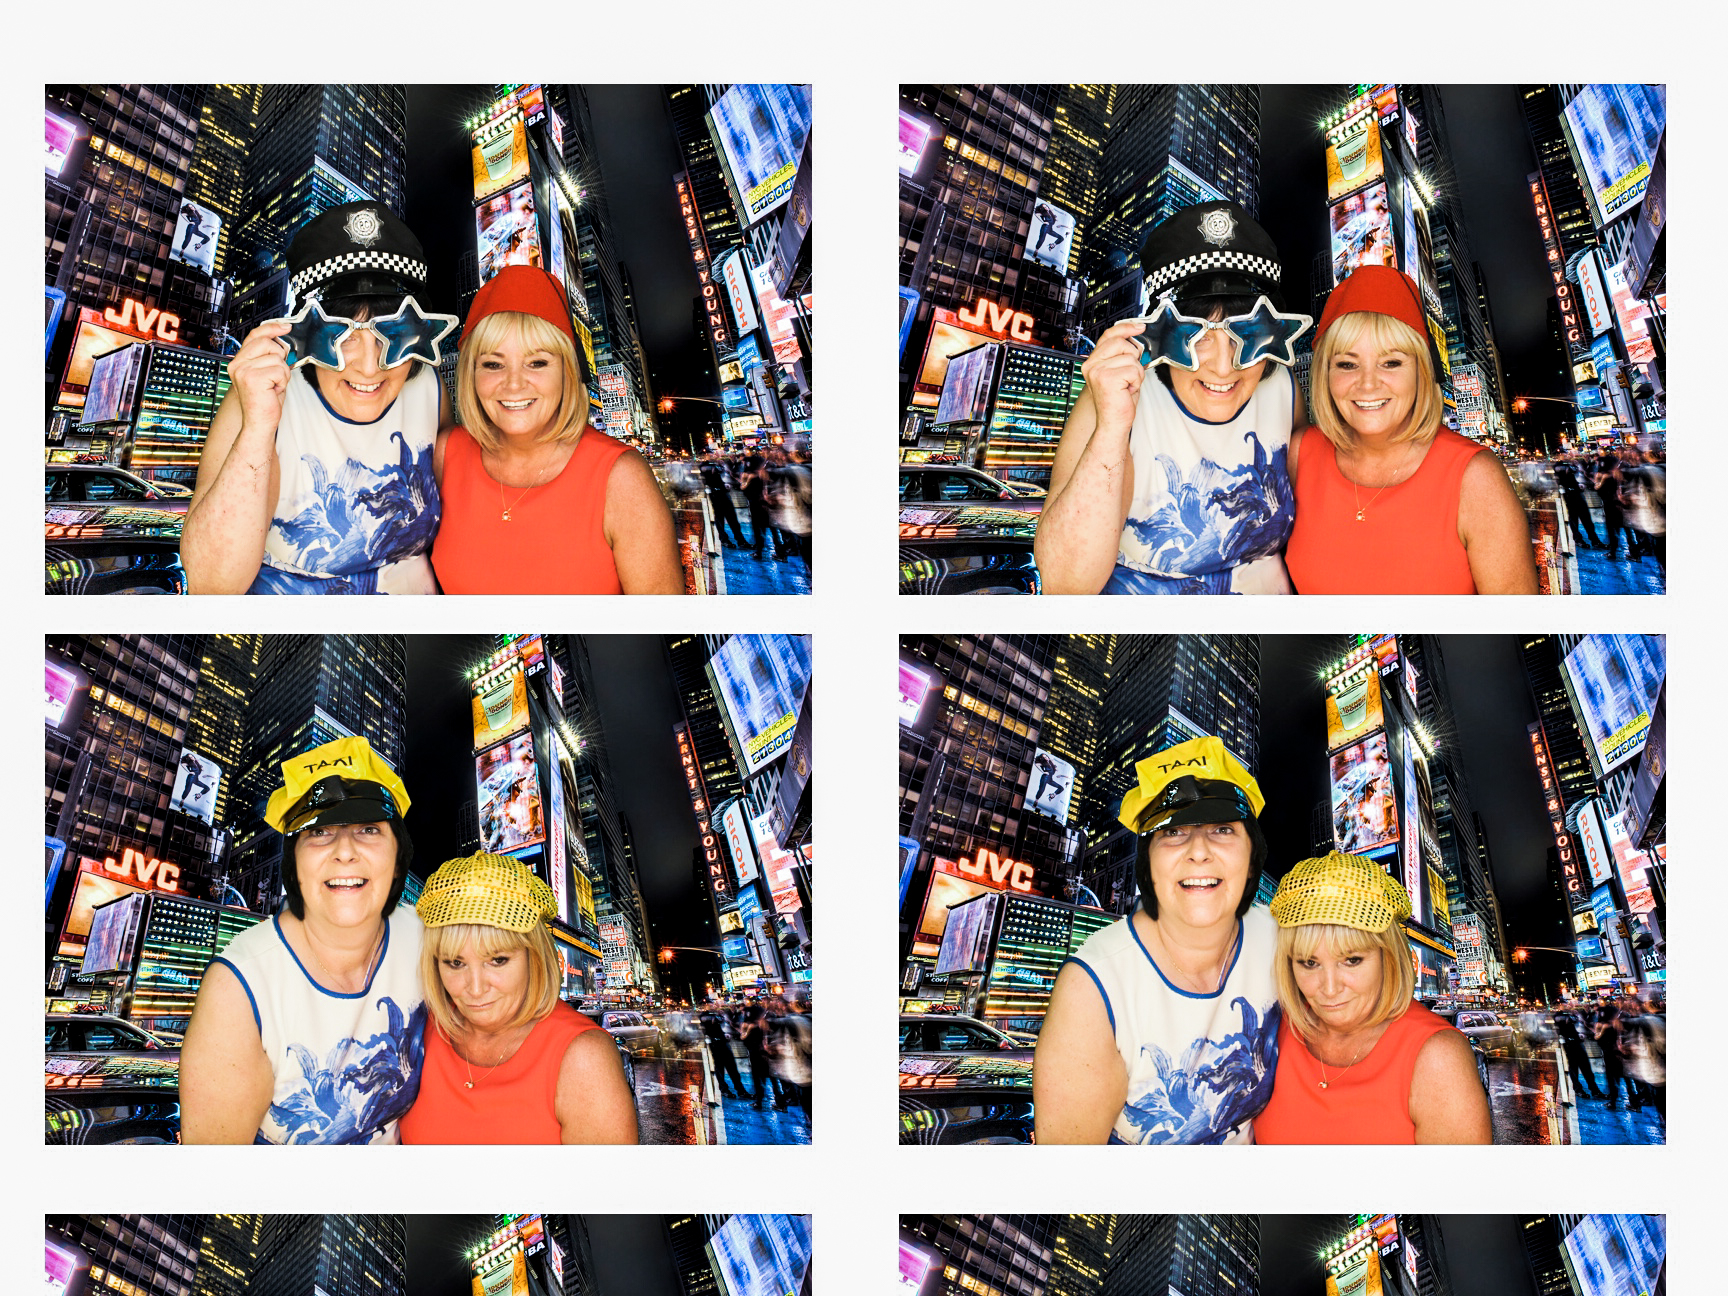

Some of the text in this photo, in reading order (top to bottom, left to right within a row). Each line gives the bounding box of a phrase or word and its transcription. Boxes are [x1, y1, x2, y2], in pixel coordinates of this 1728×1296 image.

[748, 162, 794, 199] NYC VEHICLES
[750, 185, 773, 203] COUNT
[1602, 162, 1648, 199] NYC VEHICLES
[1604, 185, 1627, 203] COUNT
[677, 181, 725, 342] ERNST & YOUNG
[1531, 181, 1579, 342] ERNST & YOUNG
[726, 263, 748, 328] RICOH
[1580, 263, 1602, 328] RICOH
[104, 297, 181, 342] JVC
[958, 297, 1035, 342] JVC
[748, 712, 794, 749] NYC VEHICLES
[750, 735, 773, 753] COUNT
[1602, 712, 1648, 749] NYC VEHICLES
[1604, 735, 1627, 753] COUNT
[677, 731, 725, 892] ERNST & YOUNG
[1531, 731, 1579, 892] ERNST & YOUNG
[726, 813, 748, 878] RICOH
[1580, 813, 1602, 878] RICOH
[104, 847, 181, 892] JVC
[958, 847, 1035, 892] JVC
